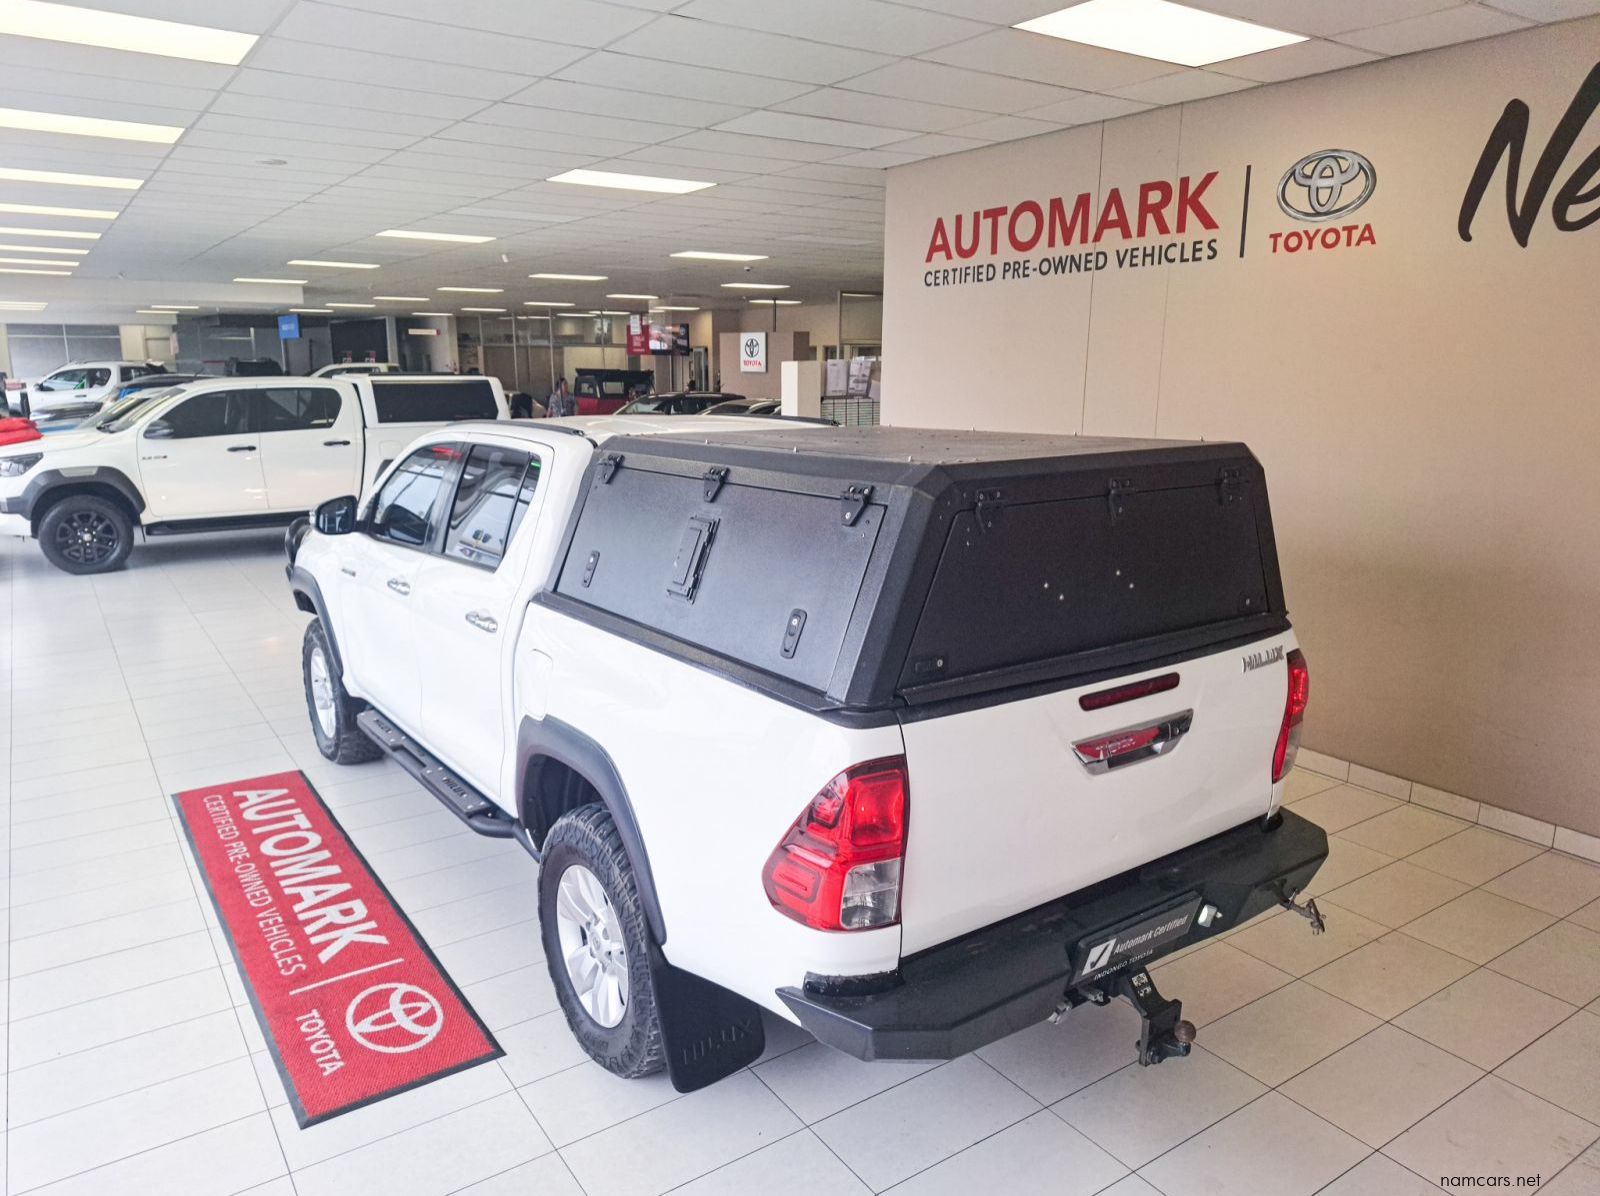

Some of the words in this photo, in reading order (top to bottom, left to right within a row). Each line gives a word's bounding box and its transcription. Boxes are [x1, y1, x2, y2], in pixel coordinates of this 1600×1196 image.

[925, 171, 1219, 263] AUTOMARK
[1269, 223, 1376, 253] TOYOTA
[924, 263, 996, 287] CERTIFIED
[1002, 250, 1108, 280] PRE-OWNED
[1115, 238, 1218, 269] VEHICLES
[203, 794, 240, 841] CERTIFIED
[225, 840, 272, 908] PRE-OWNED
[256, 907, 307, 976] VEHICLES
[232, 788, 390, 965] AUTOMARK
[1113, 930, 1154, 954] Automark
[1153, 915, 1189, 938] Certified
[296, 1008, 345, 1076] TOYOTA
